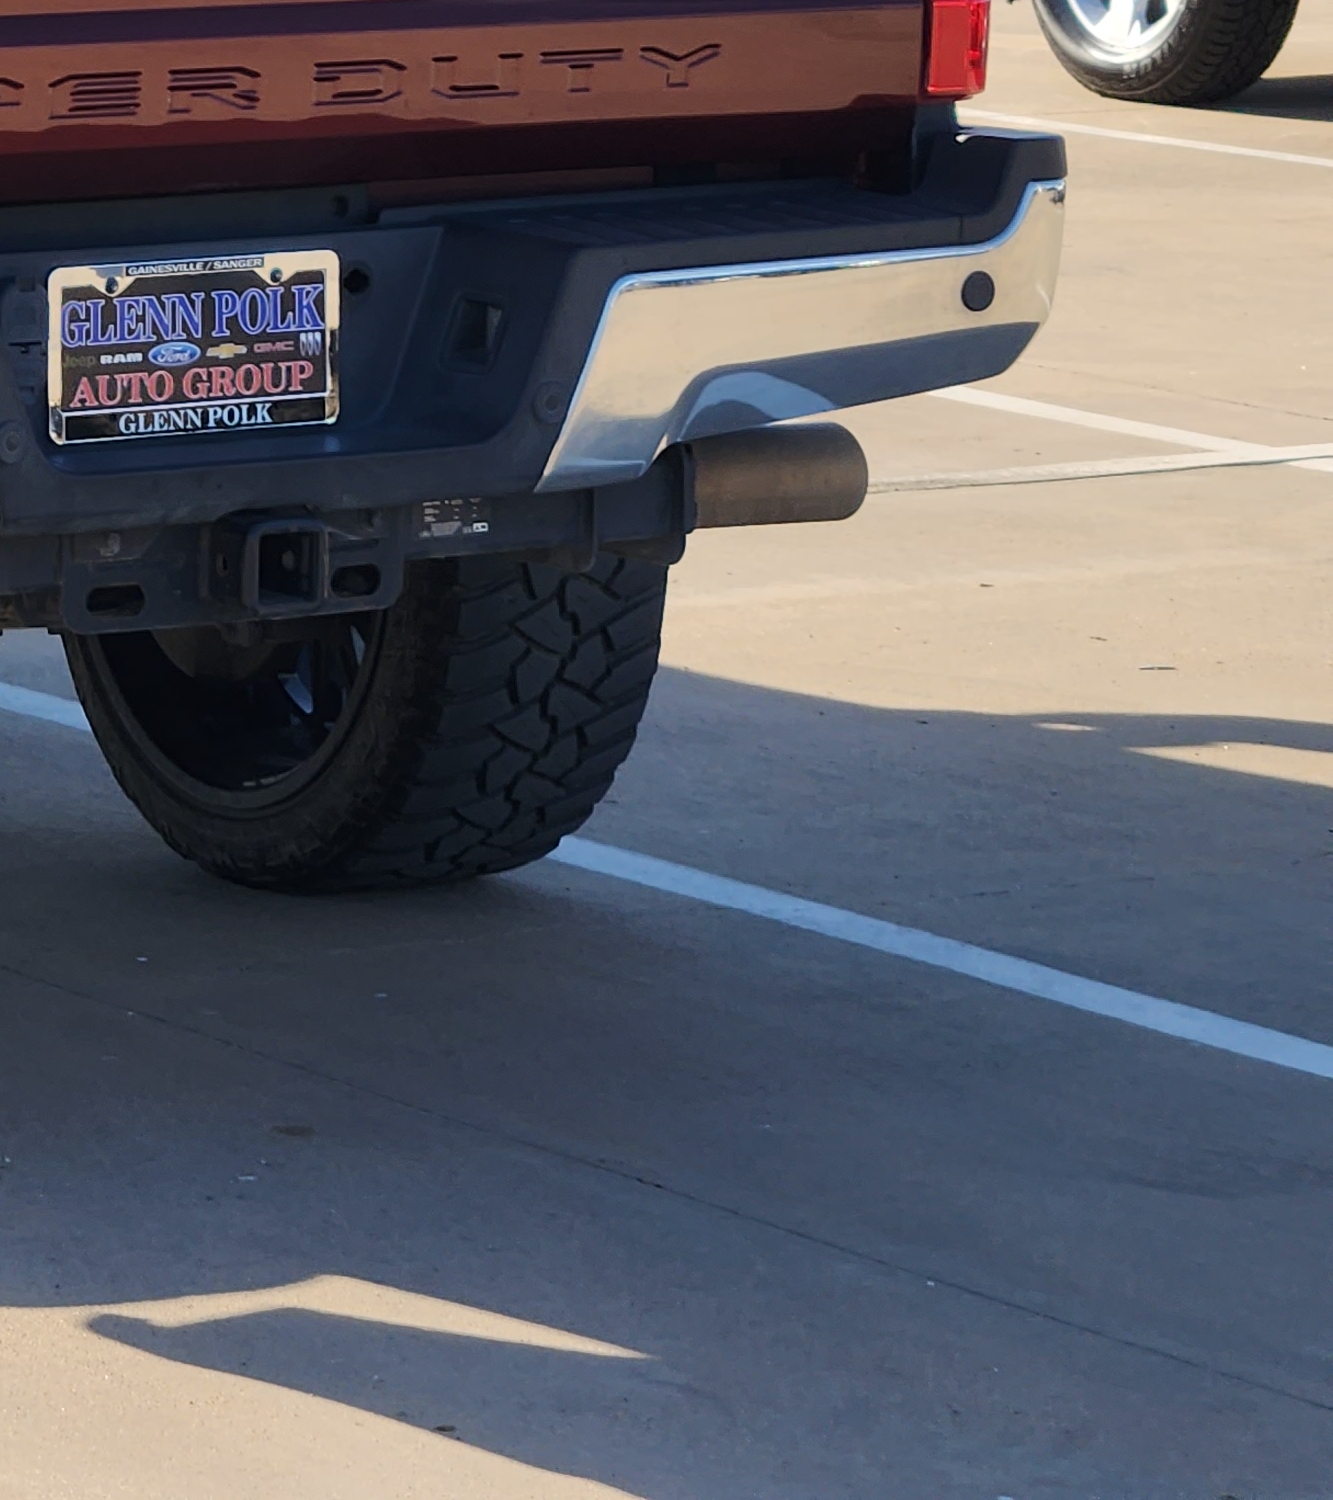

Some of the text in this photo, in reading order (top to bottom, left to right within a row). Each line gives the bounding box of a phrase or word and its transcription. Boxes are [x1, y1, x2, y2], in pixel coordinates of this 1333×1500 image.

[313, 40, 723, 107] DUTY
[126, 261, 204, 277] GAINESVILLE
[213, 257, 264, 271] SANGER
[61, 283, 326, 348] GLENN POLK
[99, 351, 144, 365] RAM
[156, 344, 194, 363] Ford
[253, 341, 295, 354] GMC
[69, 359, 315, 409] AUTO GROUP
[118, 401, 274, 436] GLENN POLK
